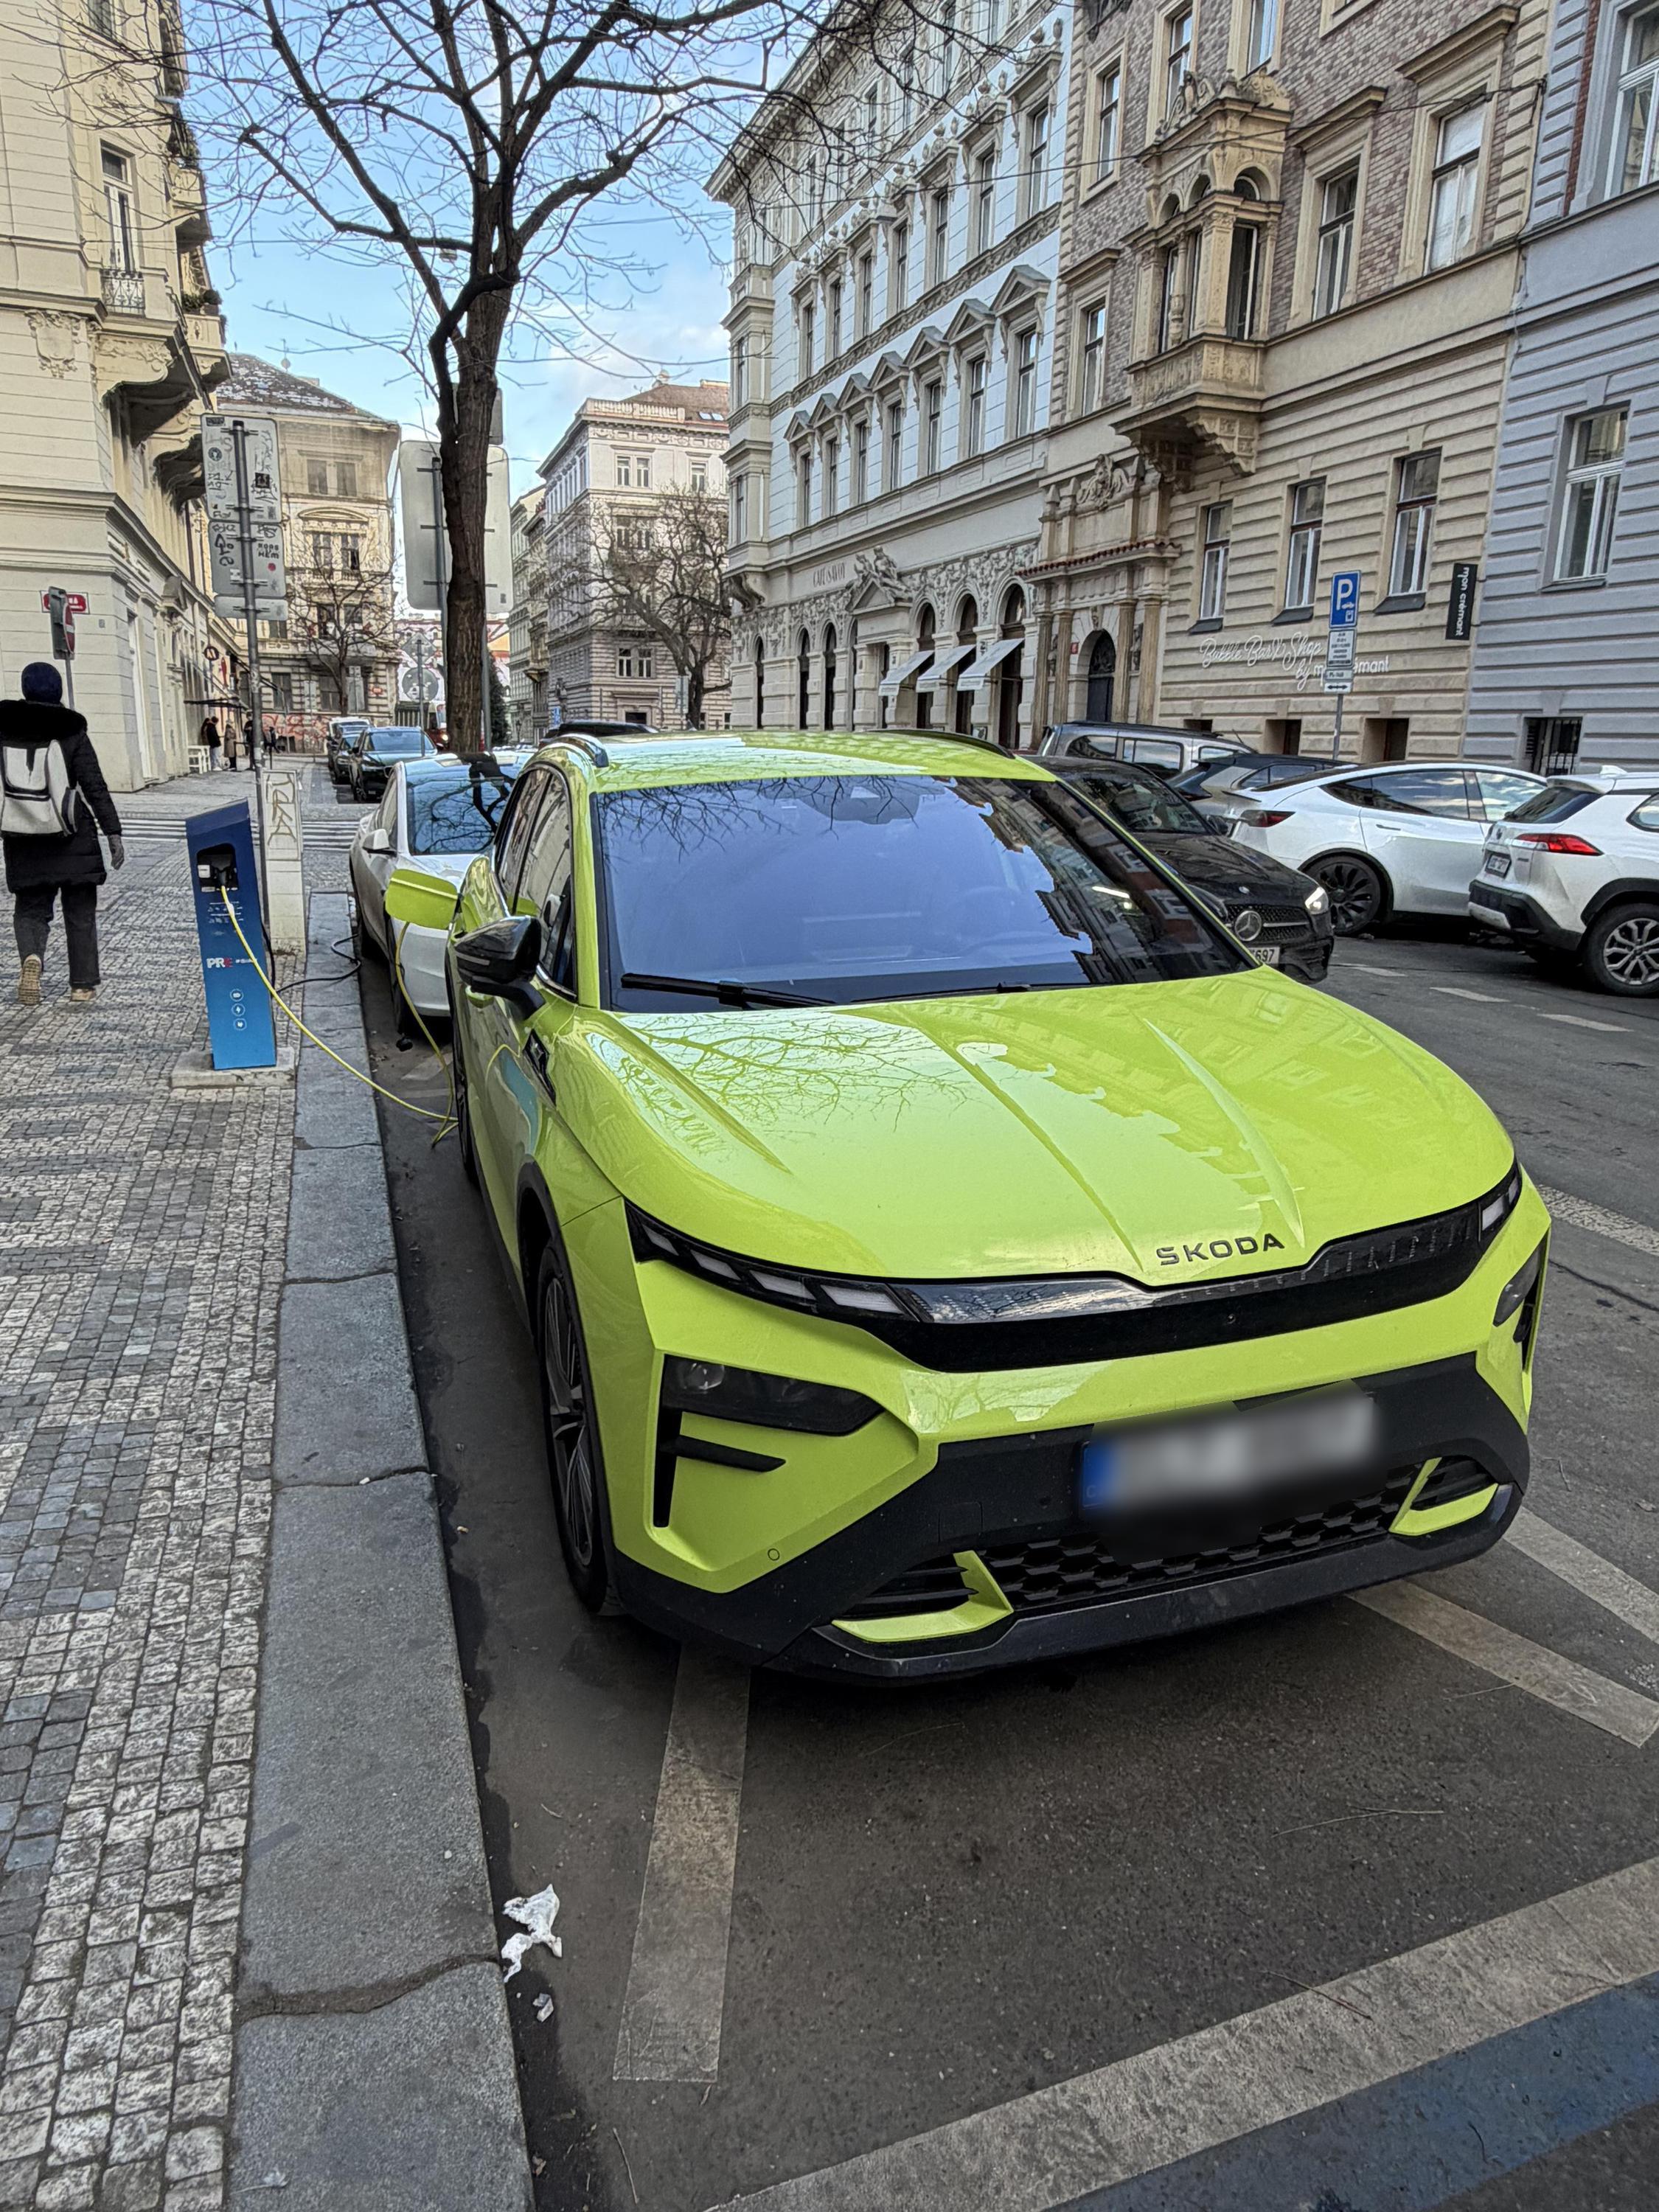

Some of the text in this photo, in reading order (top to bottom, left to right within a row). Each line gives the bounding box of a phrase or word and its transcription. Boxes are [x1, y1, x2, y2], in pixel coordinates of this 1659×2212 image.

[1457, 566, 1470, 591] mon
[1336, 579, 1353, 611] P
[1200, 637, 1242, 669] Bubble
[1282, 631, 1323, 671] Shop
[1295, 658, 1310, 691] by
[1352, 654, 1390, 675] émant
[206, 958, 233, 968] PRE
[1252, 948, 1275, 963] 697
